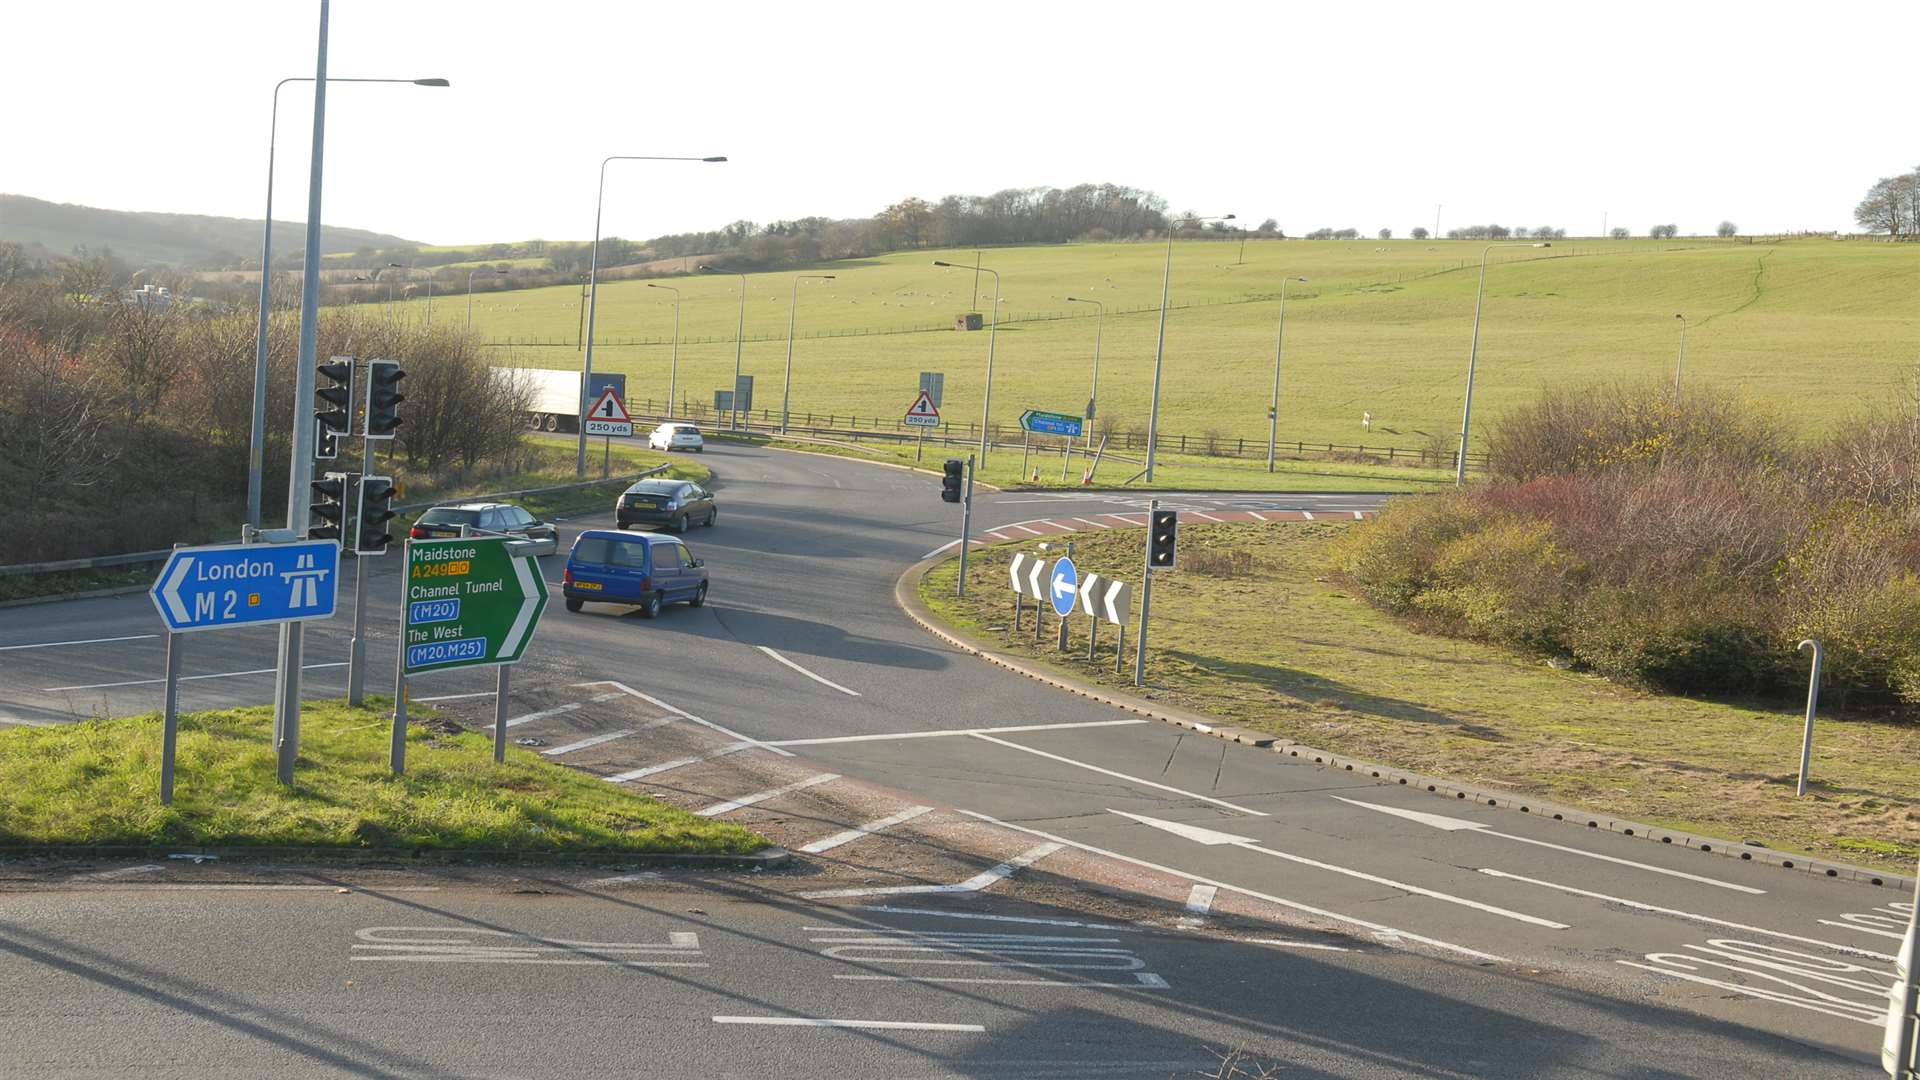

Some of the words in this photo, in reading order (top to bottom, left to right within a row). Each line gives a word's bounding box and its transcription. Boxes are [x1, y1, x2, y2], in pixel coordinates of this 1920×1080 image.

[590, 423, 610, 432] 250
[611, 425, 628, 433] yds
[412, 547, 477, 562] Maidstone
[198, 558, 274, 582] London
[410, 583, 460, 599] Channel
[465, 578, 503, 594] Tunnel
[414, 602, 456, 621] (M20)
[407, 629, 429, 643] The
[433, 624, 463, 639] West
